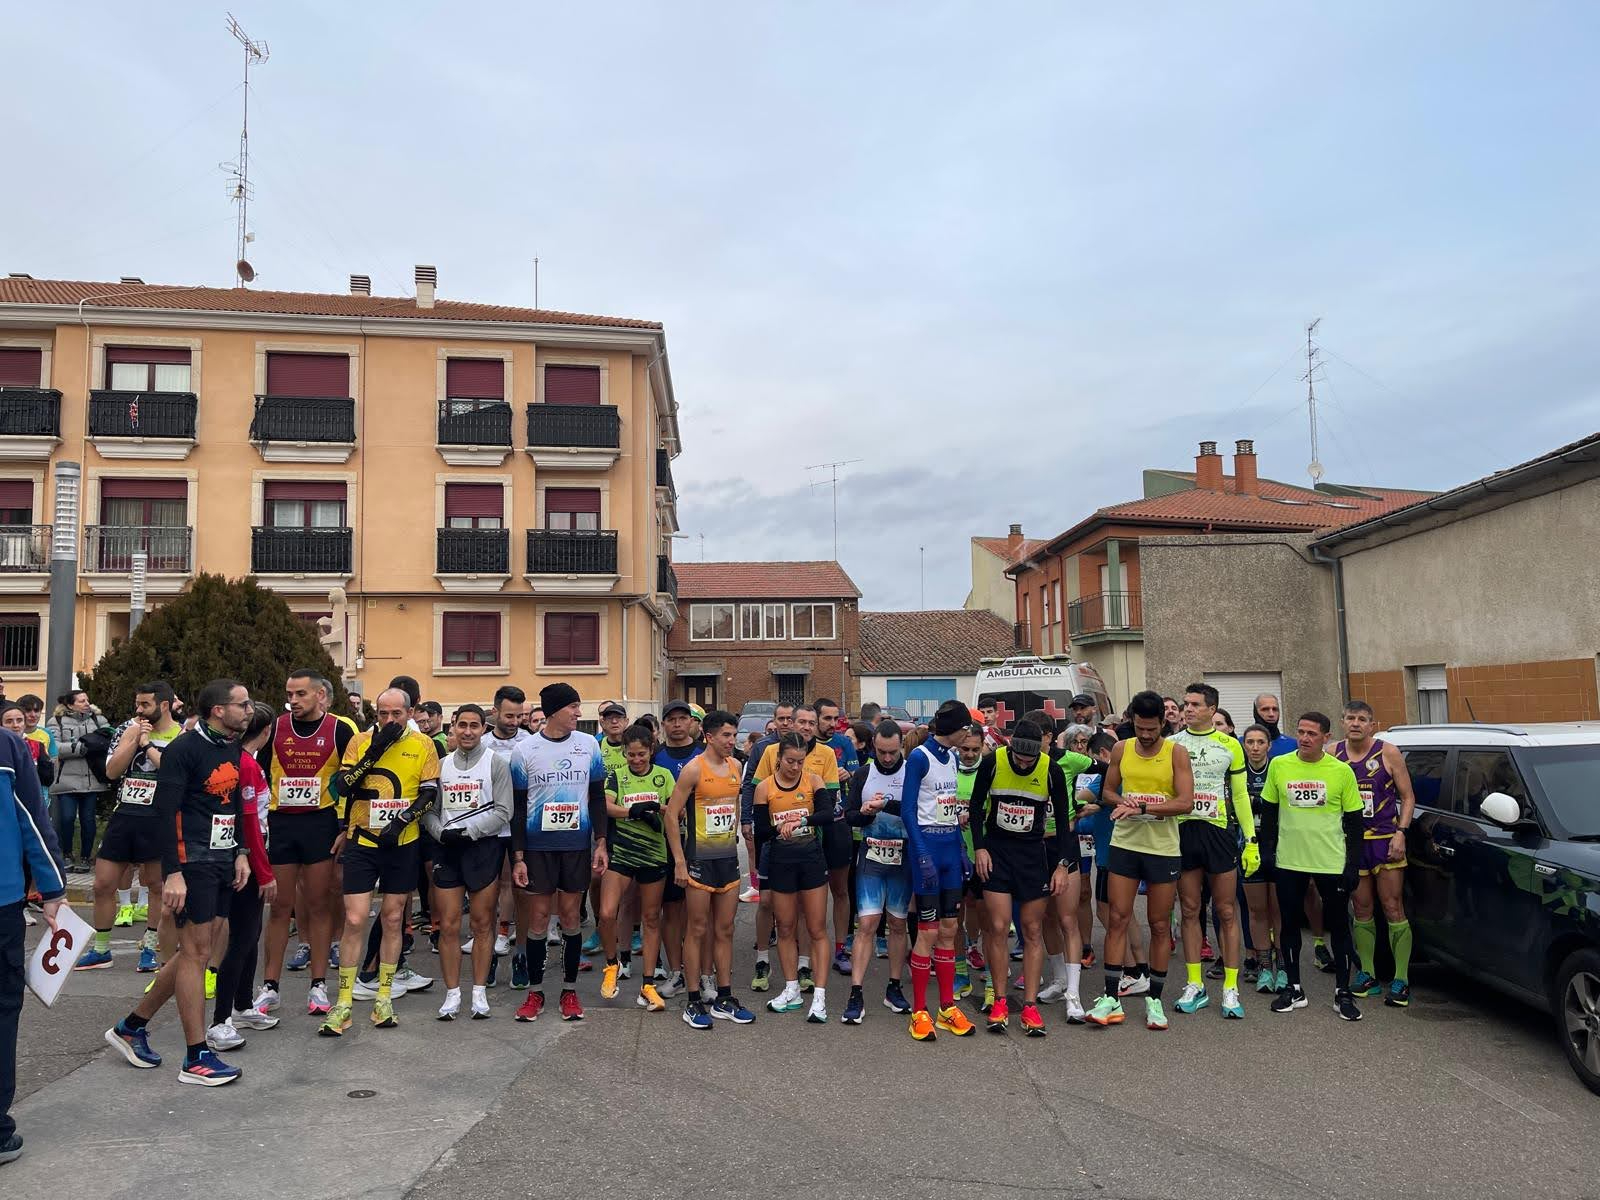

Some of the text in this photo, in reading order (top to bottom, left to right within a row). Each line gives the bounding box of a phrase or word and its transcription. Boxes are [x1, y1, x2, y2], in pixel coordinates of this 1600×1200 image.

[986, 667, 1062, 678] AMBULANCIA
[534, 770, 589, 784] INFINITY
[1286, 781, 1326, 790] bedunia
[126, 786, 147, 799] 272
[287, 787, 312, 799] 376
[449, 791, 472, 803] 315
[624, 793, 658, 803] bedunia
[1295, 789, 1319, 801] 285
[371, 800, 409, 809] bedunia
[550, 812, 574, 824] 357
[713, 815, 732, 827] 317
[1003, 813, 1025, 826] 361
[874, 846, 895, 858] 313
